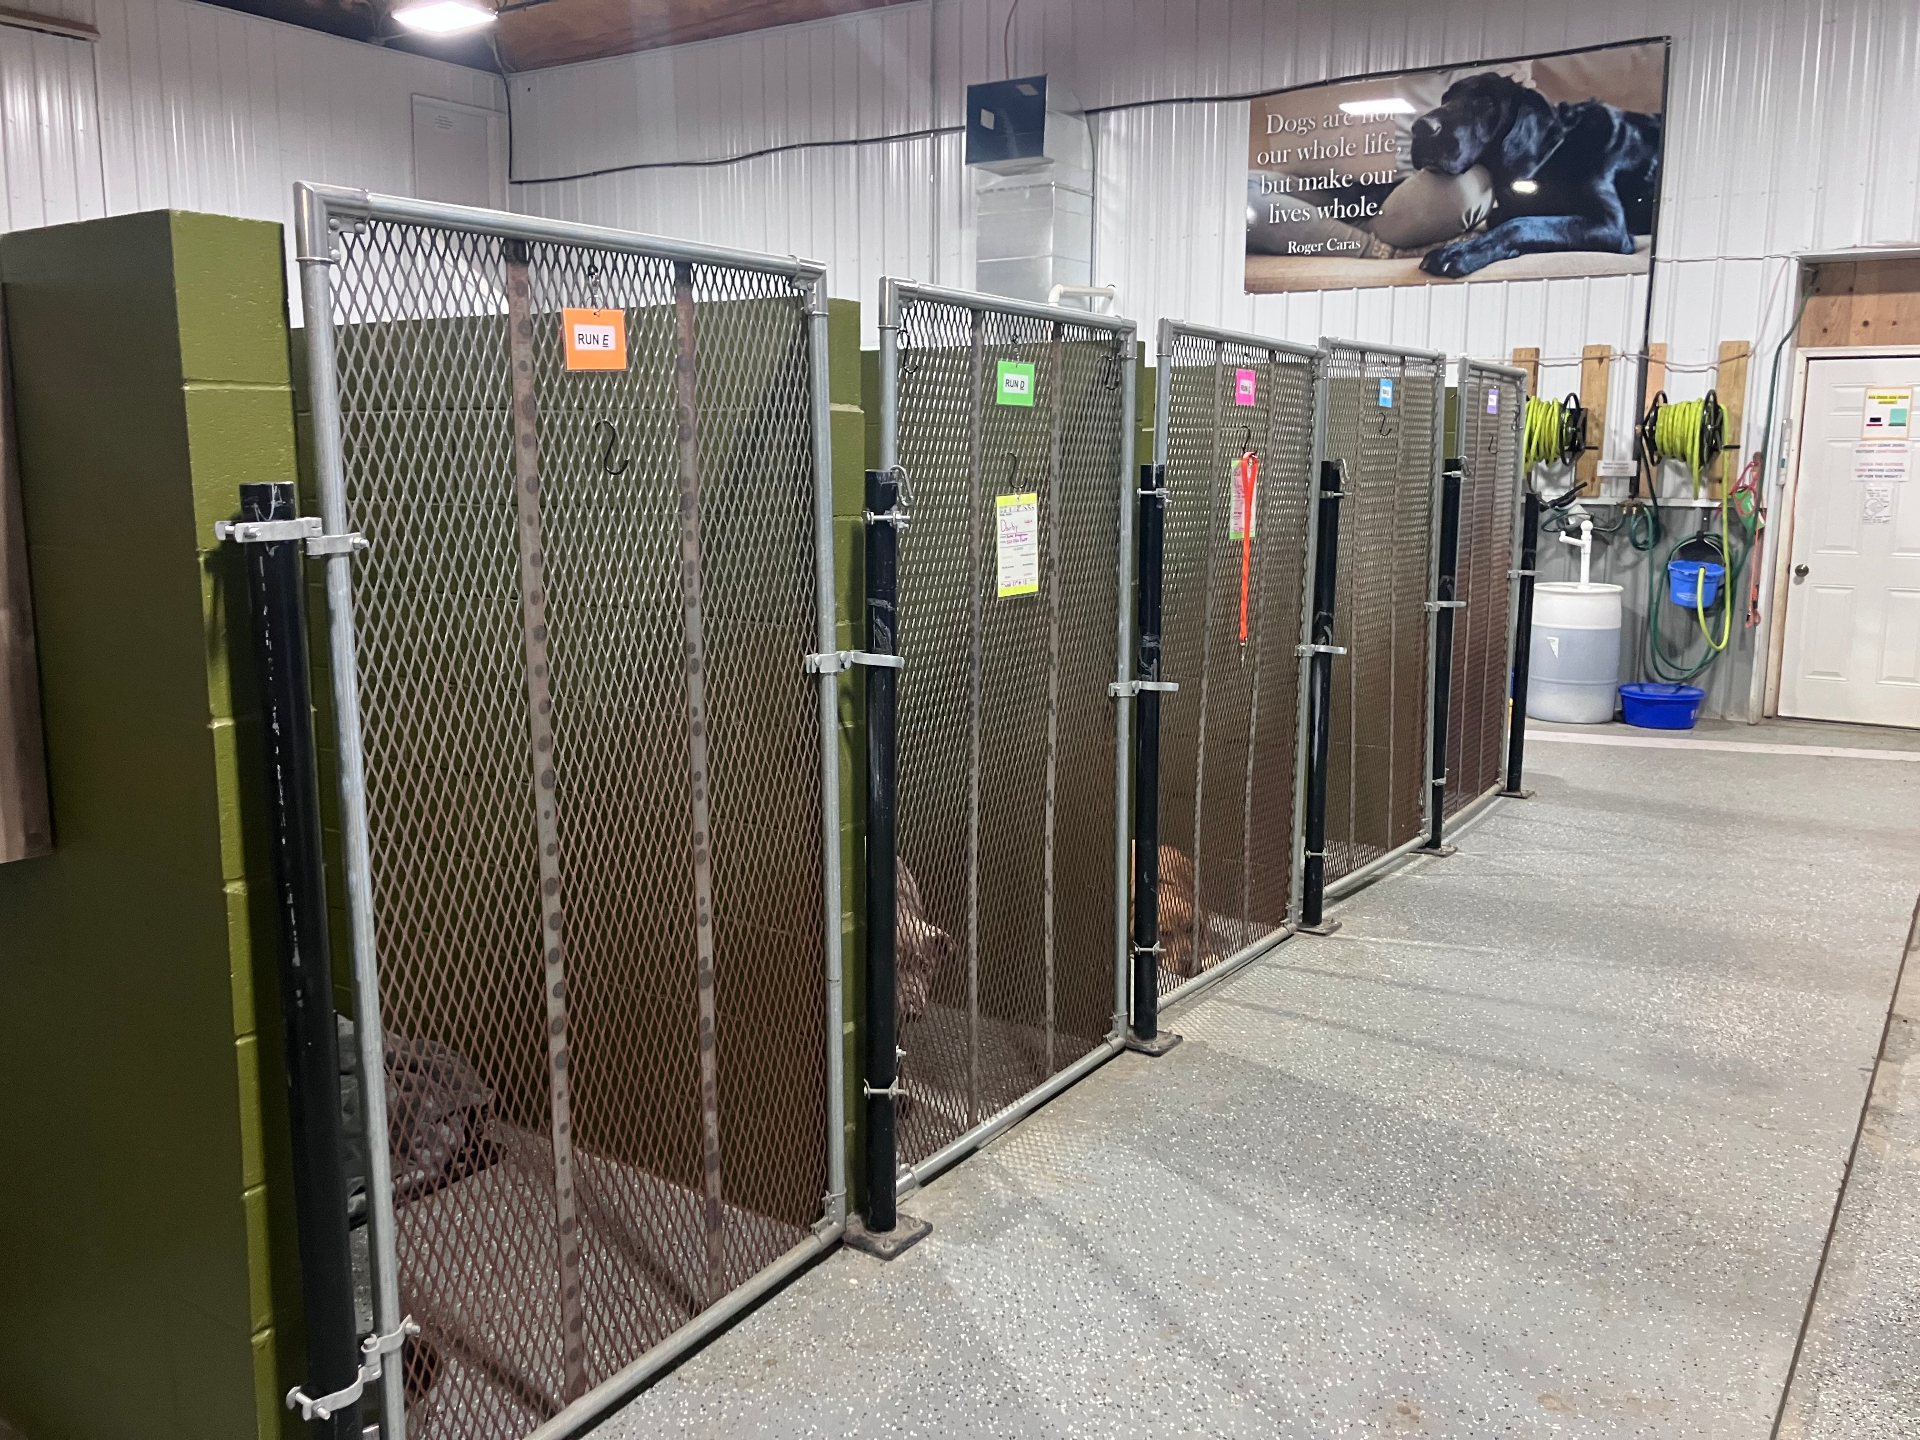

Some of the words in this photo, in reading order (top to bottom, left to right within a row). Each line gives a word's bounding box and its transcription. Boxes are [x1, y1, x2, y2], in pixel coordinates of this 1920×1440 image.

[1266, 113, 1316, 135] Dogs
[1323, 113, 1354, 128] are
[1256, 148, 1292, 165] our
[1297, 137, 1357, 161] whole
[1364, 132, 1402, 155] life,
[1260, 175, 1293, 195] but
[1298, 168, 1354, 192] make
[1359, 169, 1398, 186] our
[1268, 203, 1311, 224] lives
[1316, 196, 1384, 219] whole.
[1287, 240, 1324, 255] Roger
[1326, 237, 1361, 251] Caras
[577, 333, 600, 345] RUN
[602, 335, 609, 347] E
[1005, 378, 1019, 388] RUN
